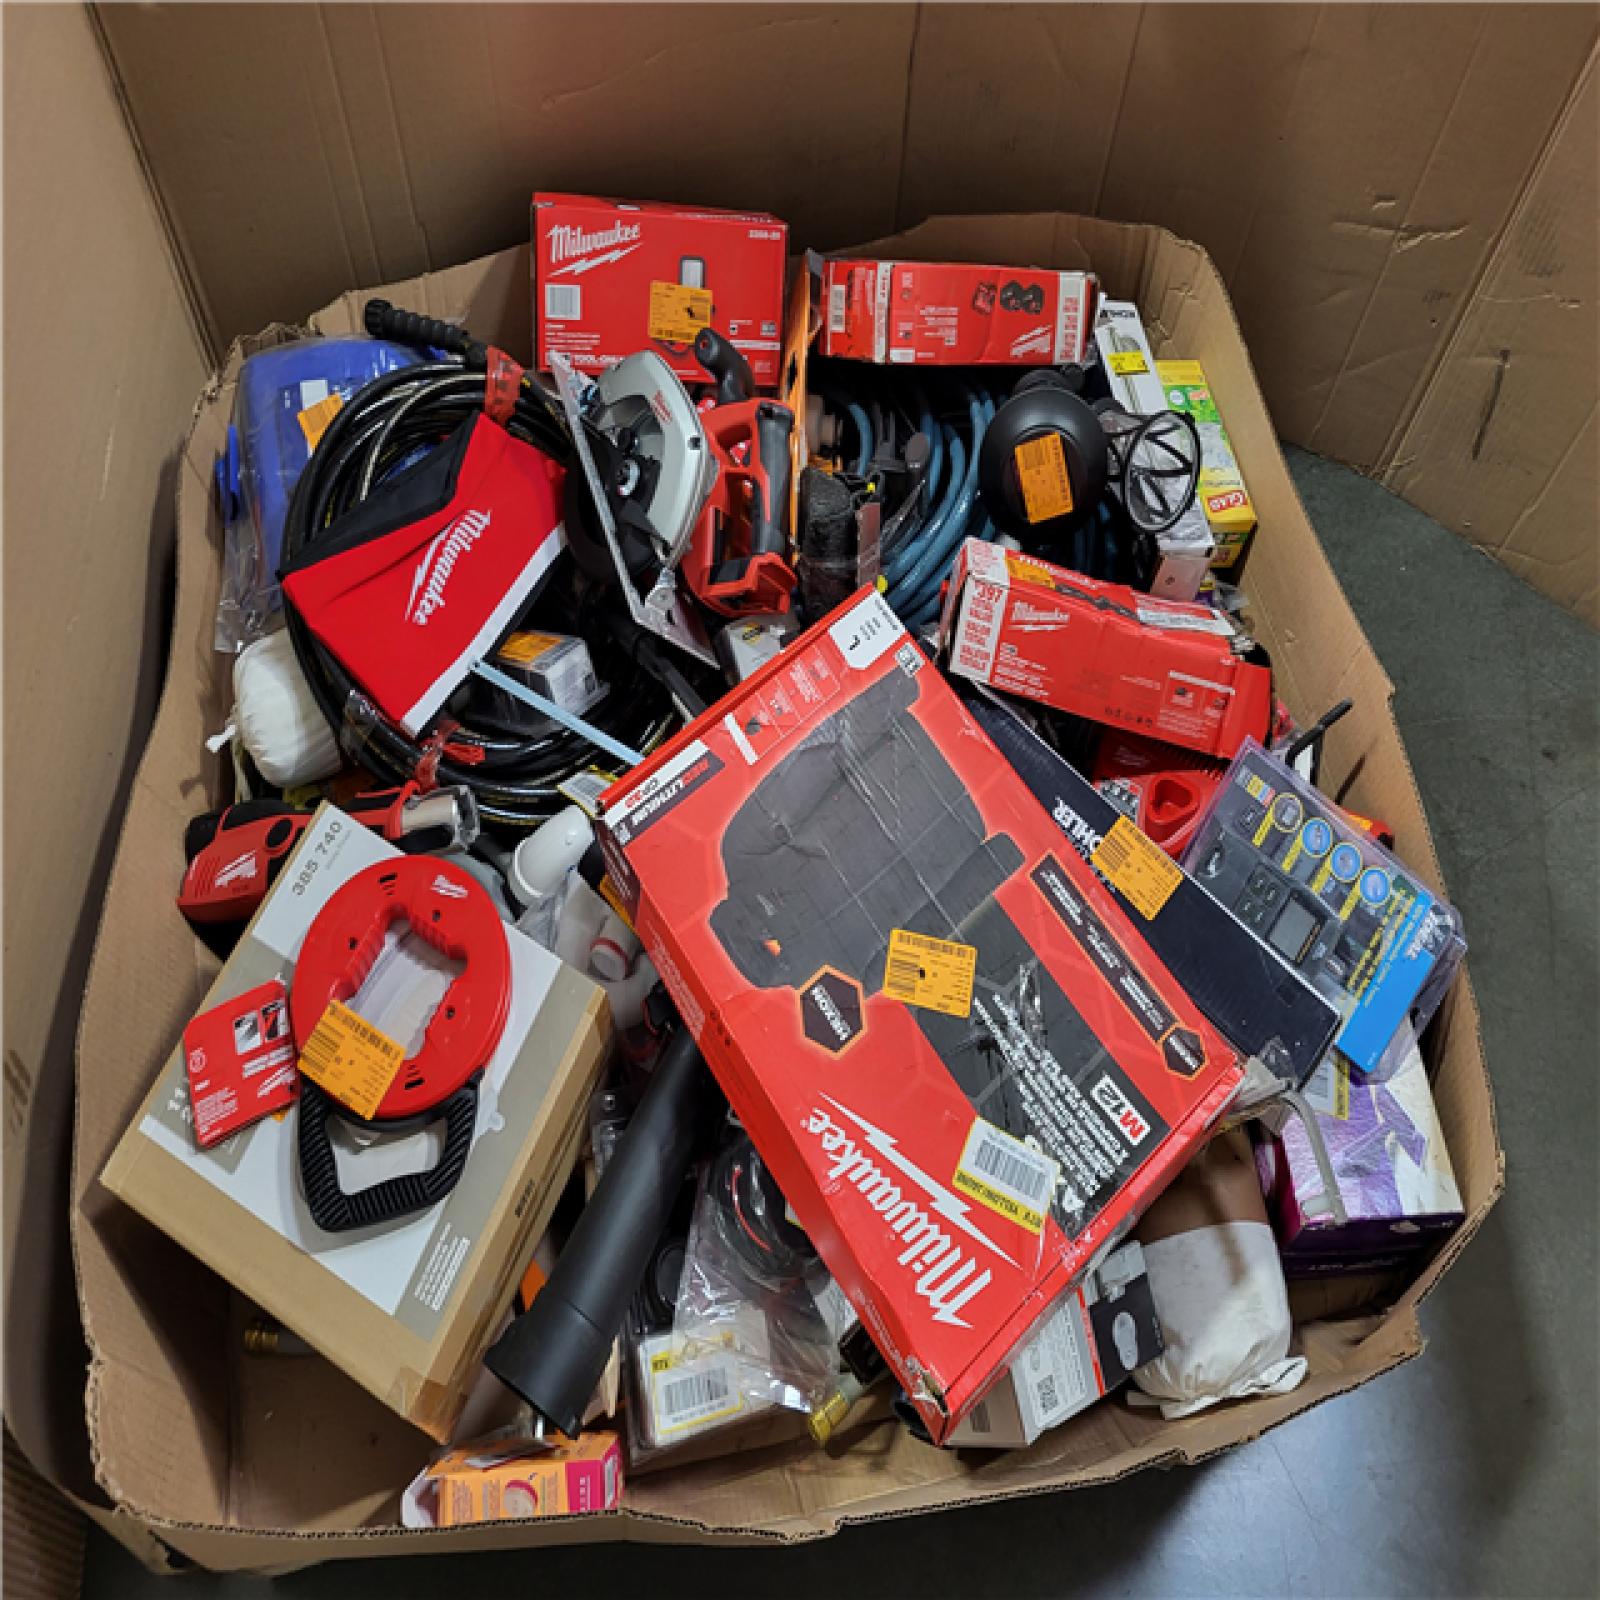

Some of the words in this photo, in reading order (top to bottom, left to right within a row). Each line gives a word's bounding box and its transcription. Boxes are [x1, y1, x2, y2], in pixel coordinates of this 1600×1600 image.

[545, 220, 640, 263] Milwaukee
[413, 509, 491, 625] Milwaukee
[1011, 601, 1070, 624] Milwaukee
[1049, 798, 1104, 853] OHLER
[292, 861, 320, 897] 385
[315, 821, 343, 855] 740
[808, 985, 849, 1041] HEXON
[1093, 1080, 1147, 1141] M12
[806, 1107, 992, 1330] Milwaukee
